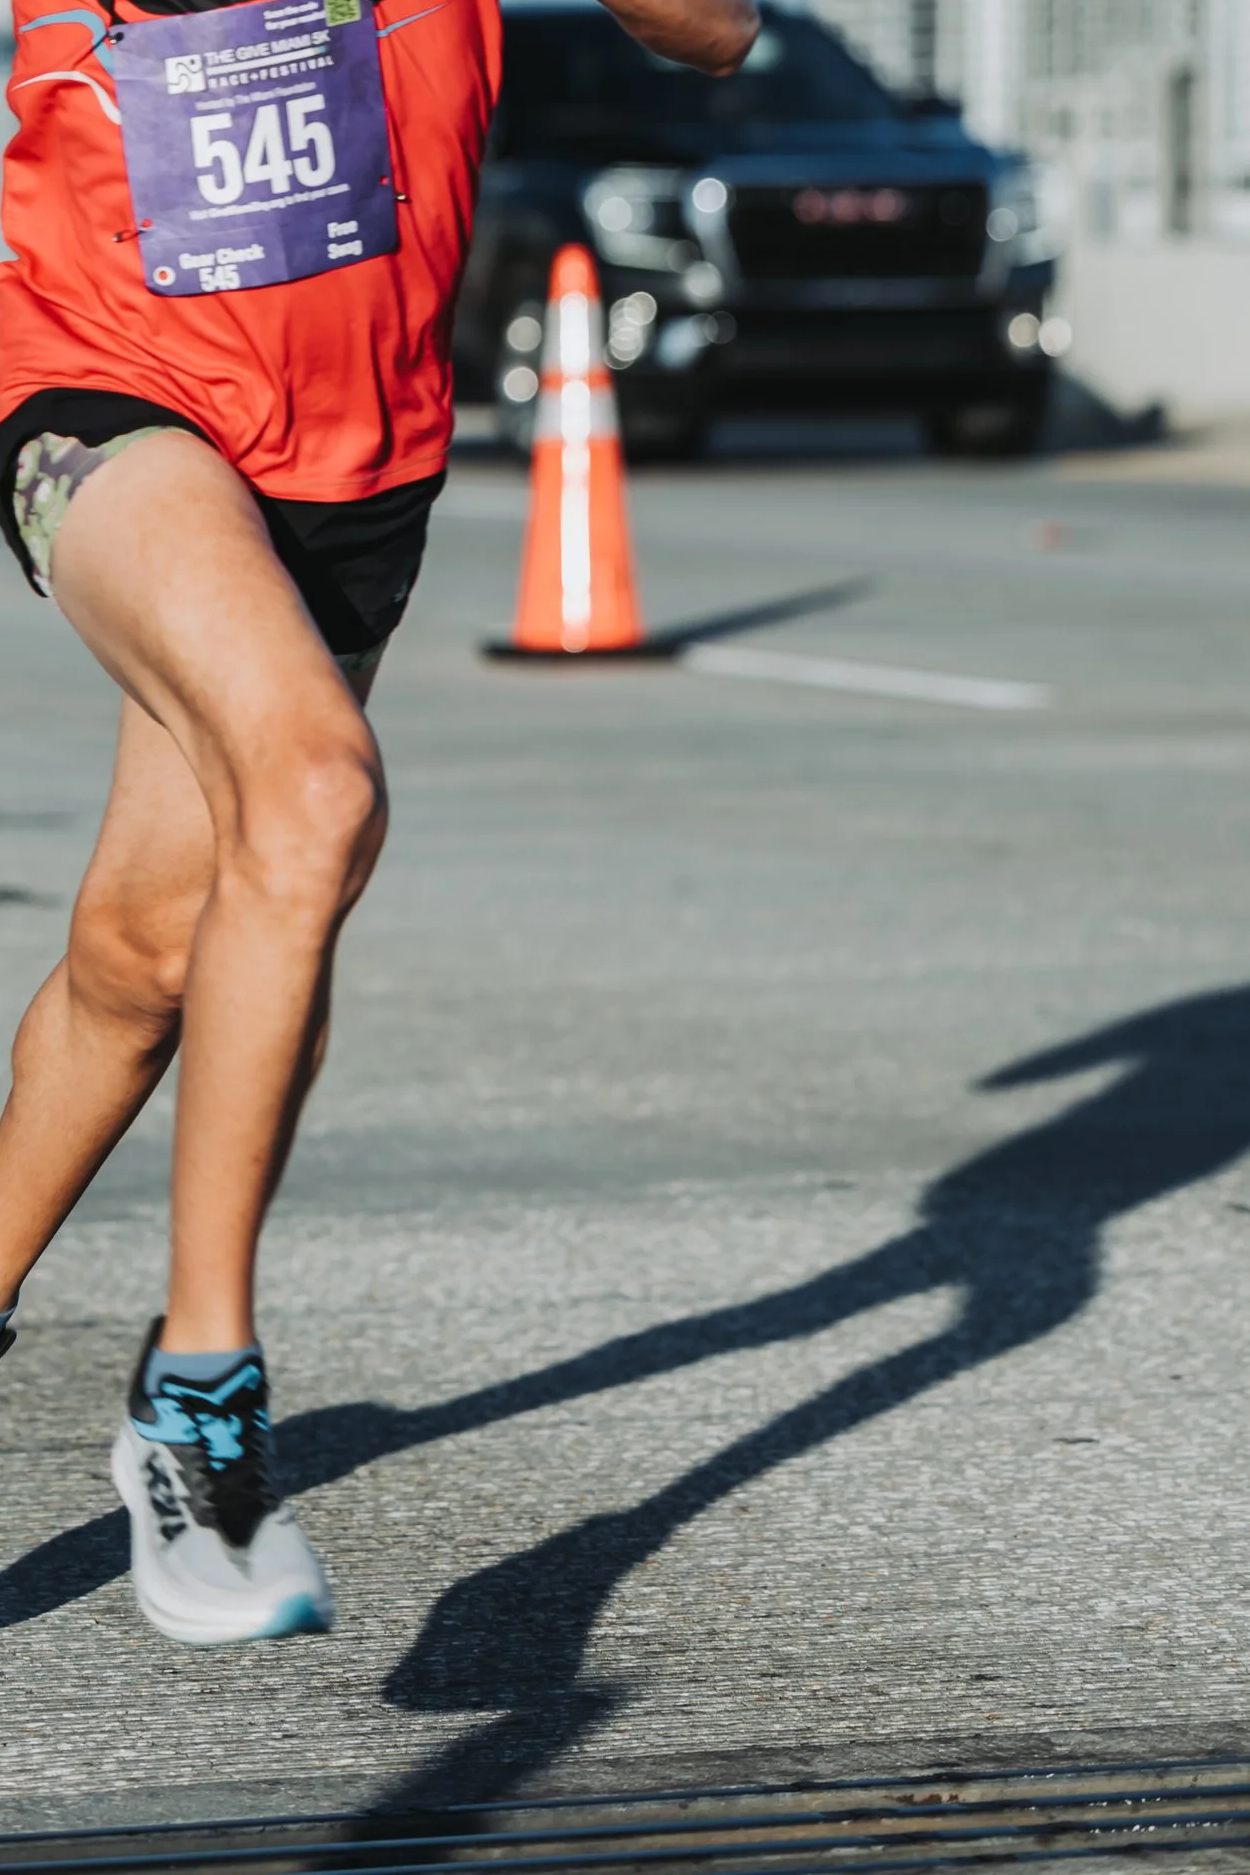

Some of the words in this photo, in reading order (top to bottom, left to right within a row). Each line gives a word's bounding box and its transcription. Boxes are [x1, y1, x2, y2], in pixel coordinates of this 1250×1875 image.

[203, 49, 235, 66] THE
[189, 94, 336, 205] 545
[198, 264, 240, 292] 545
